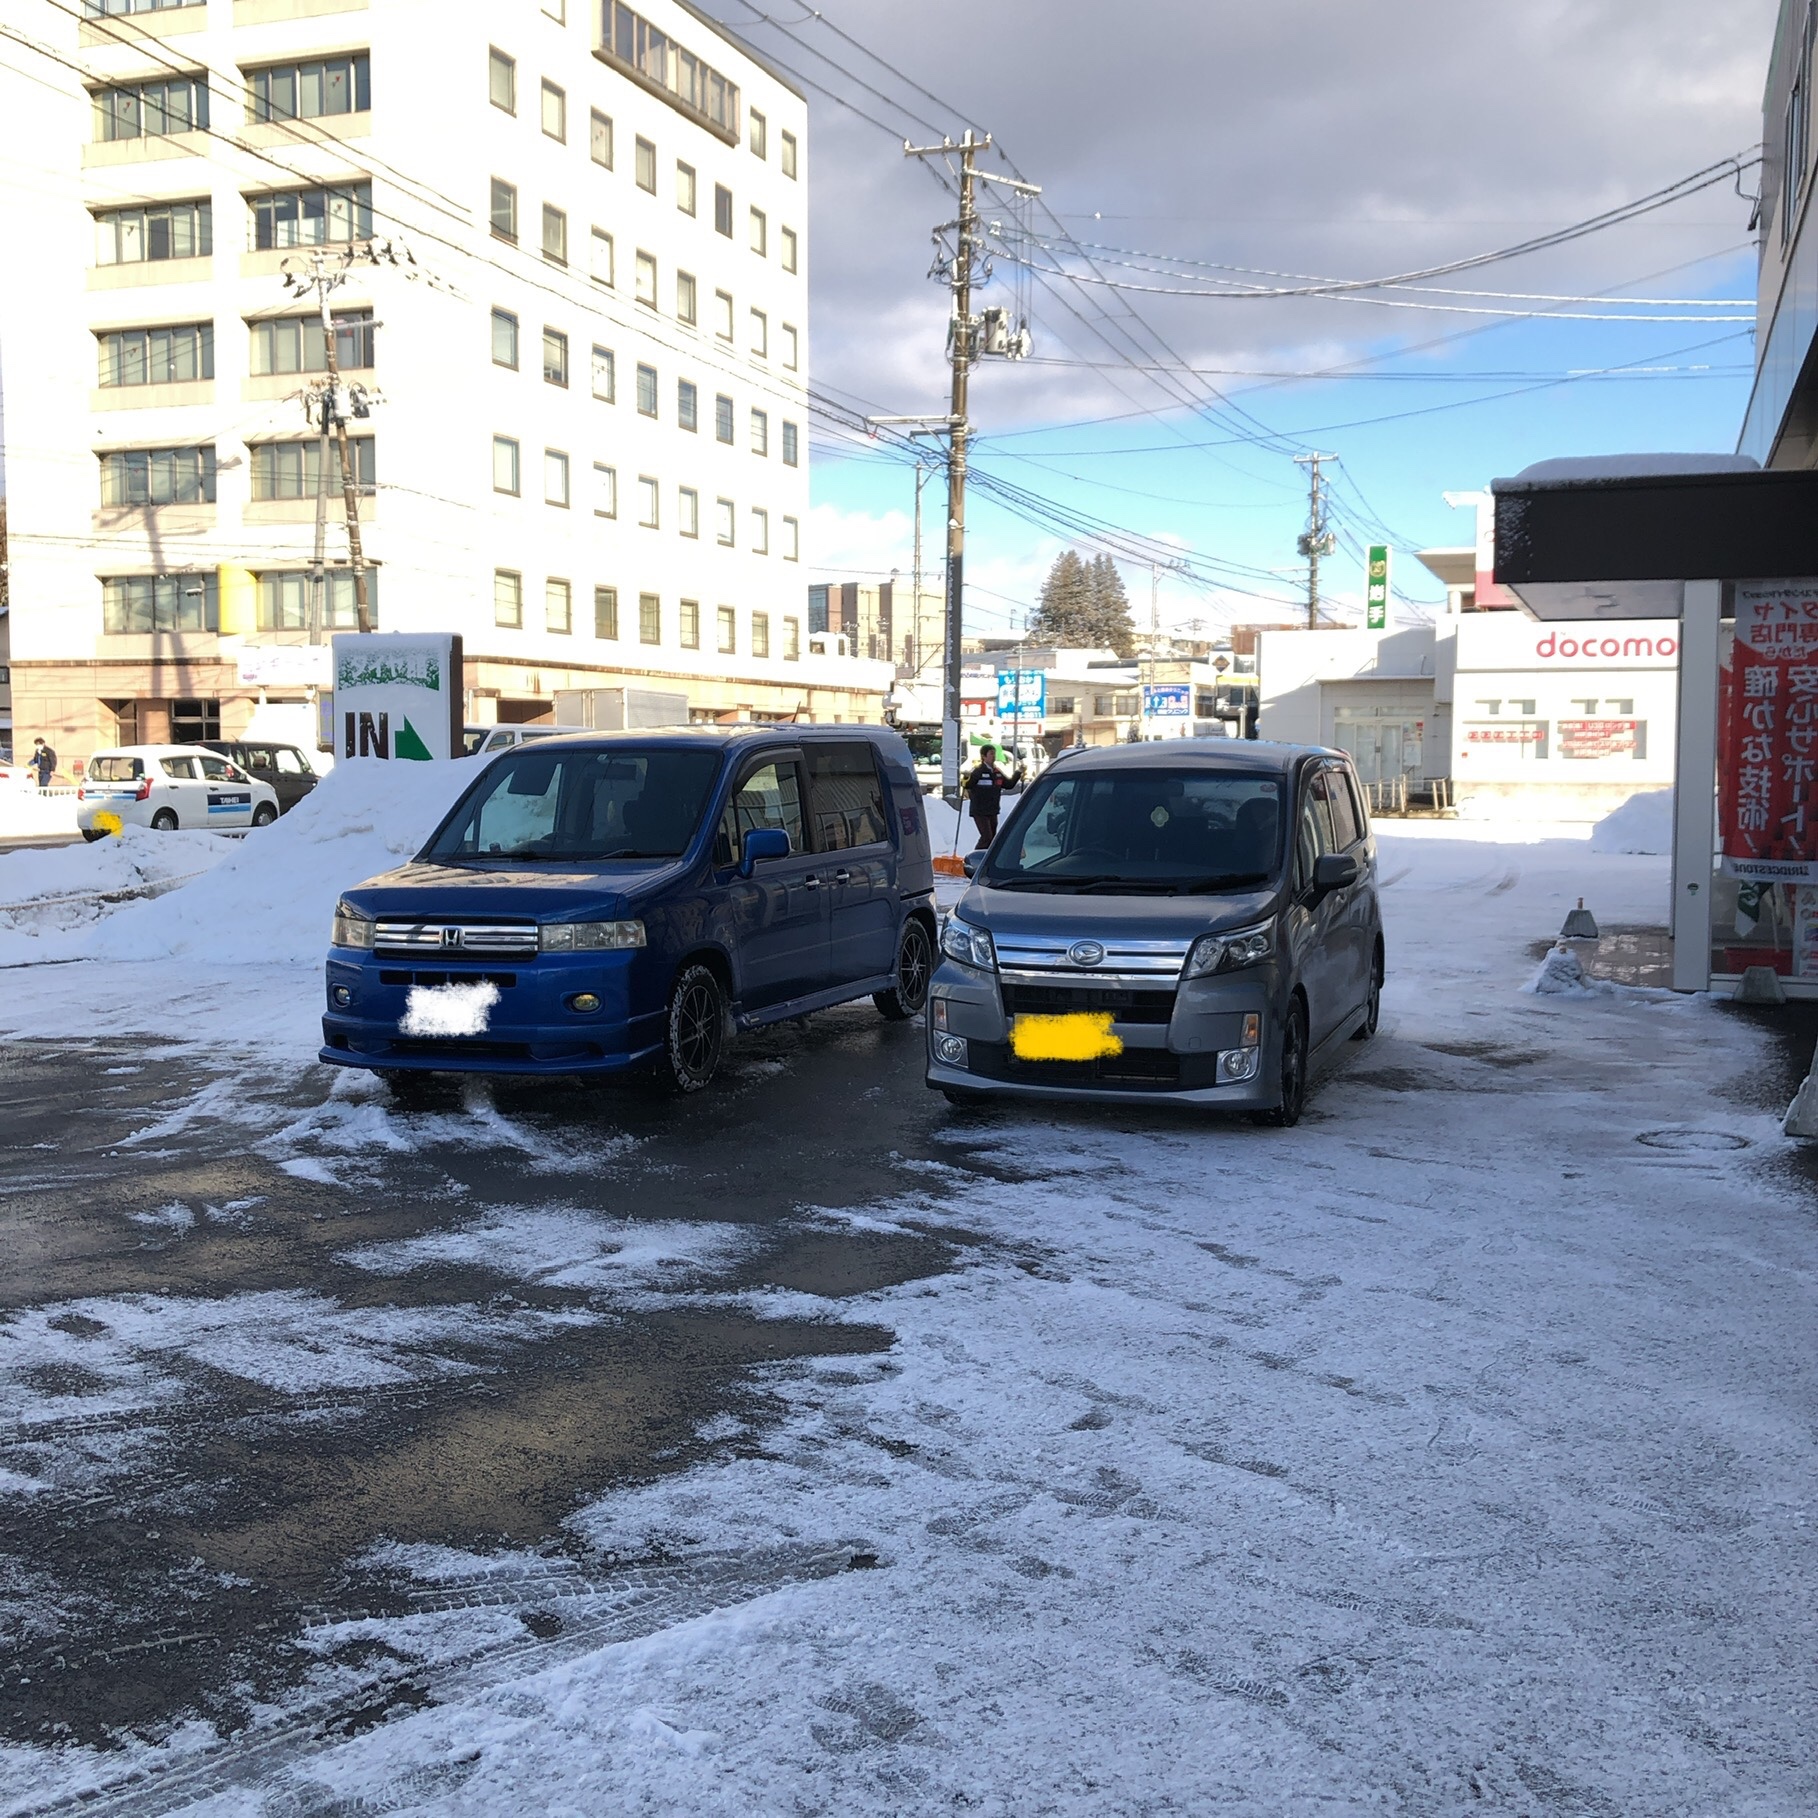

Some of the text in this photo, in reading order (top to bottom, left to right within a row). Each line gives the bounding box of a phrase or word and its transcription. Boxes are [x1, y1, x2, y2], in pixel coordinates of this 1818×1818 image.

[1368, 584, 1385, 624] 岩手
[1536, 631, 1678, 658] docomo
[344, 711, 390, 760] IN
